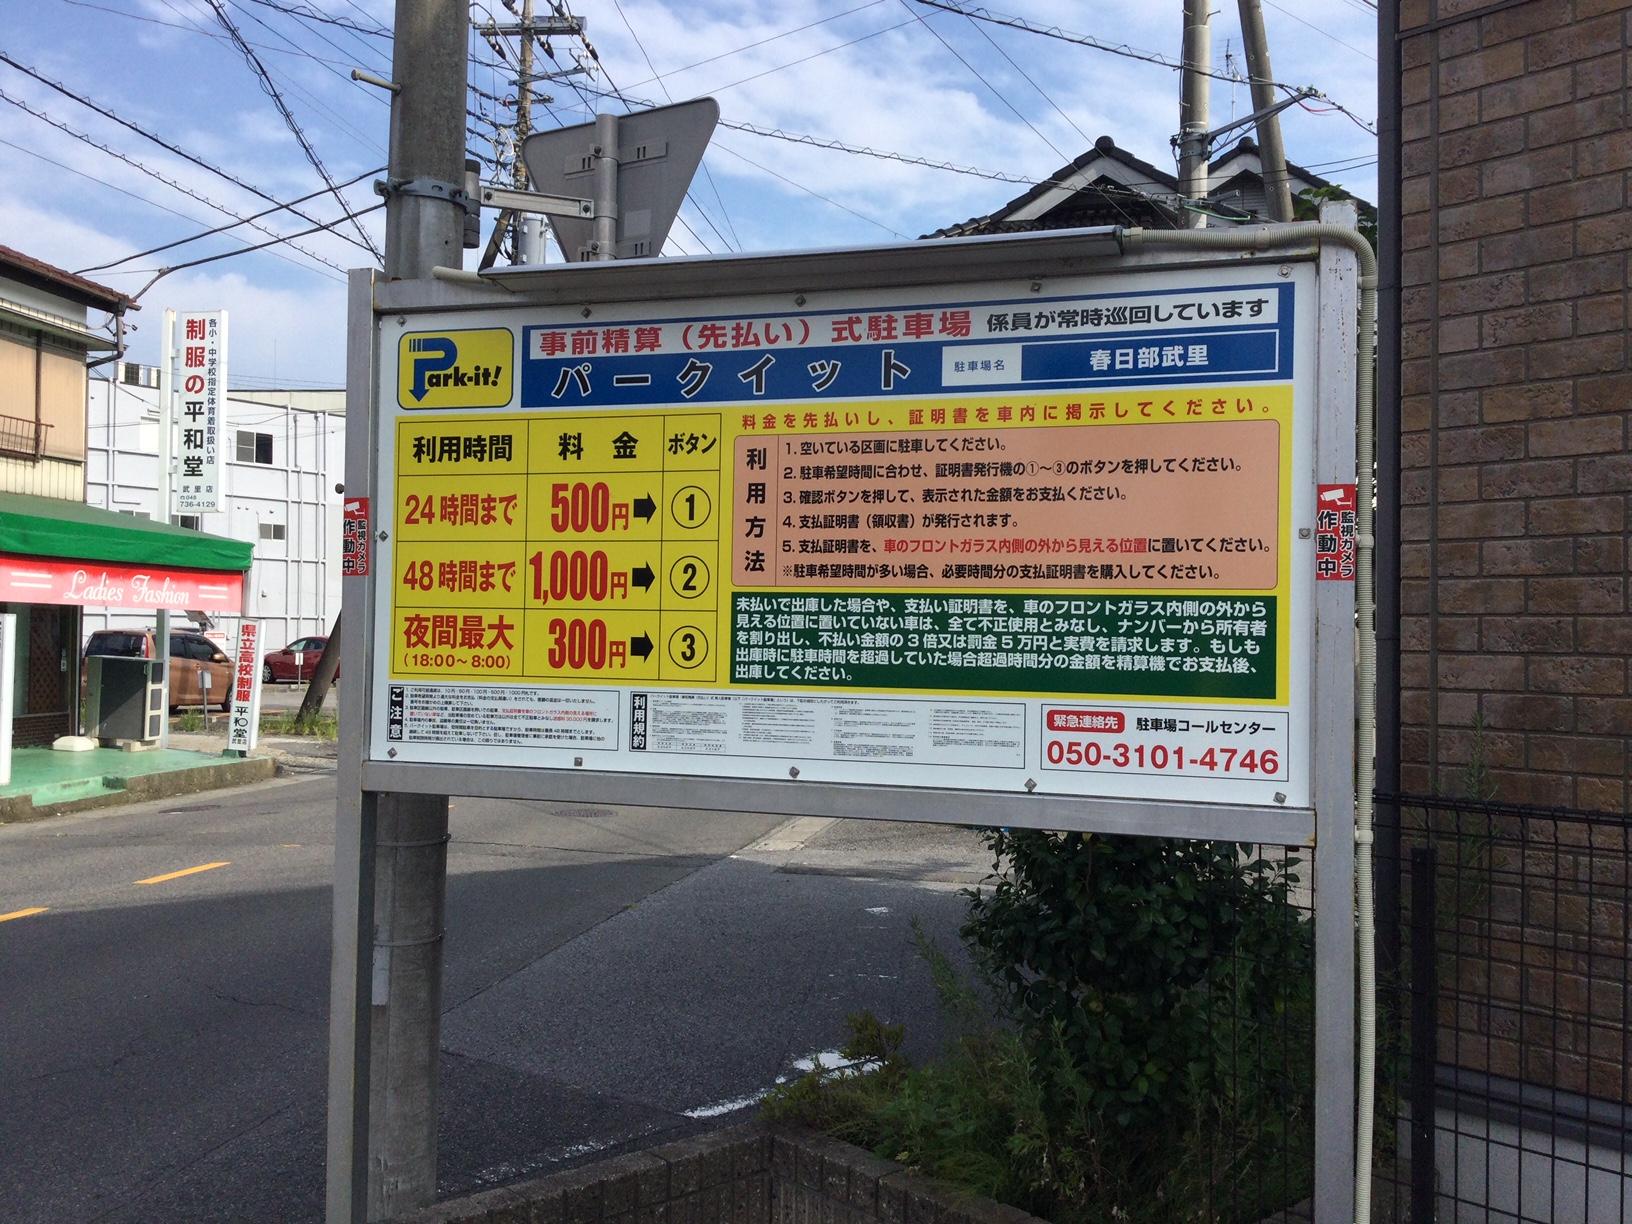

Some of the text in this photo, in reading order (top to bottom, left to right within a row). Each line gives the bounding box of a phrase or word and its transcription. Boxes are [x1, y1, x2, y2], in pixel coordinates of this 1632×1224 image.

[539, 298, 1270, 356] 事前精算（先払い）式駐車場 係員が常時巡回しています
[550, 349, 911, 399] パークイット
[954, 359, 1005, 373] 駐車場名
[1089, 344, 1209, 371] 春日部武里
[183, 318, 206, 477] 制服の平和堂
[742, 398, 1269, 430] 料金を先払いし、証明書を車内に掲示してください。
[412, 434, 513, 464] 利用時間
[668, 432, 717, 456] ボタン
[800, 437, 1007, 457] 空いている区画に駐車してください。
[183, 485, 213, 494] 武里店
[799, 485, 1127, 505] 確認ボタンを押して、表示された金額をお支払ください。
[404, 493, 518, 527] 24時間まで
[550, 481, 630, 533] 500円
[744, 447, 768, 573] 利用方法
[799, 512, 1018, 529] 支払証明書（領収書）が発行されます。
[356, 519, 368, 574] 監視カメラ
[1317, 509, 1338, 577] 作動中
[1340, 509, 1356, 578] 監視カメラ
[63, 569, 190, 606] Ladies Fashion
[403, 560, 517, 593] 48時間まで
[528, 550, 628, 605] 1,000円
[736, 596, 1267, 617] 未払いで出庫した場合や、支払い証明書を、車のフロントガラス内側の外から
[403, 614, 515, 651] 夜間最大
[736, 614, 1268, 637] 見える位置に置いていない車は、全て不正使用とみなし、ナンバーから所有者
[547, 618, 627, 670] 300円
[235, 624, 257, 702] 県立高校制服
[735, 665, 853, 681] 出庫してください。
[233, 705, 249, 738] 平和堂
[390, 687, 402, 739] ご注意
[632, 695, 647, 749] 利用規約
[1053, 714, 1277, 735] 緊急連絡先 駐車場コールセンター
[1047, 740, 1279, 775] 050-3101-4746
